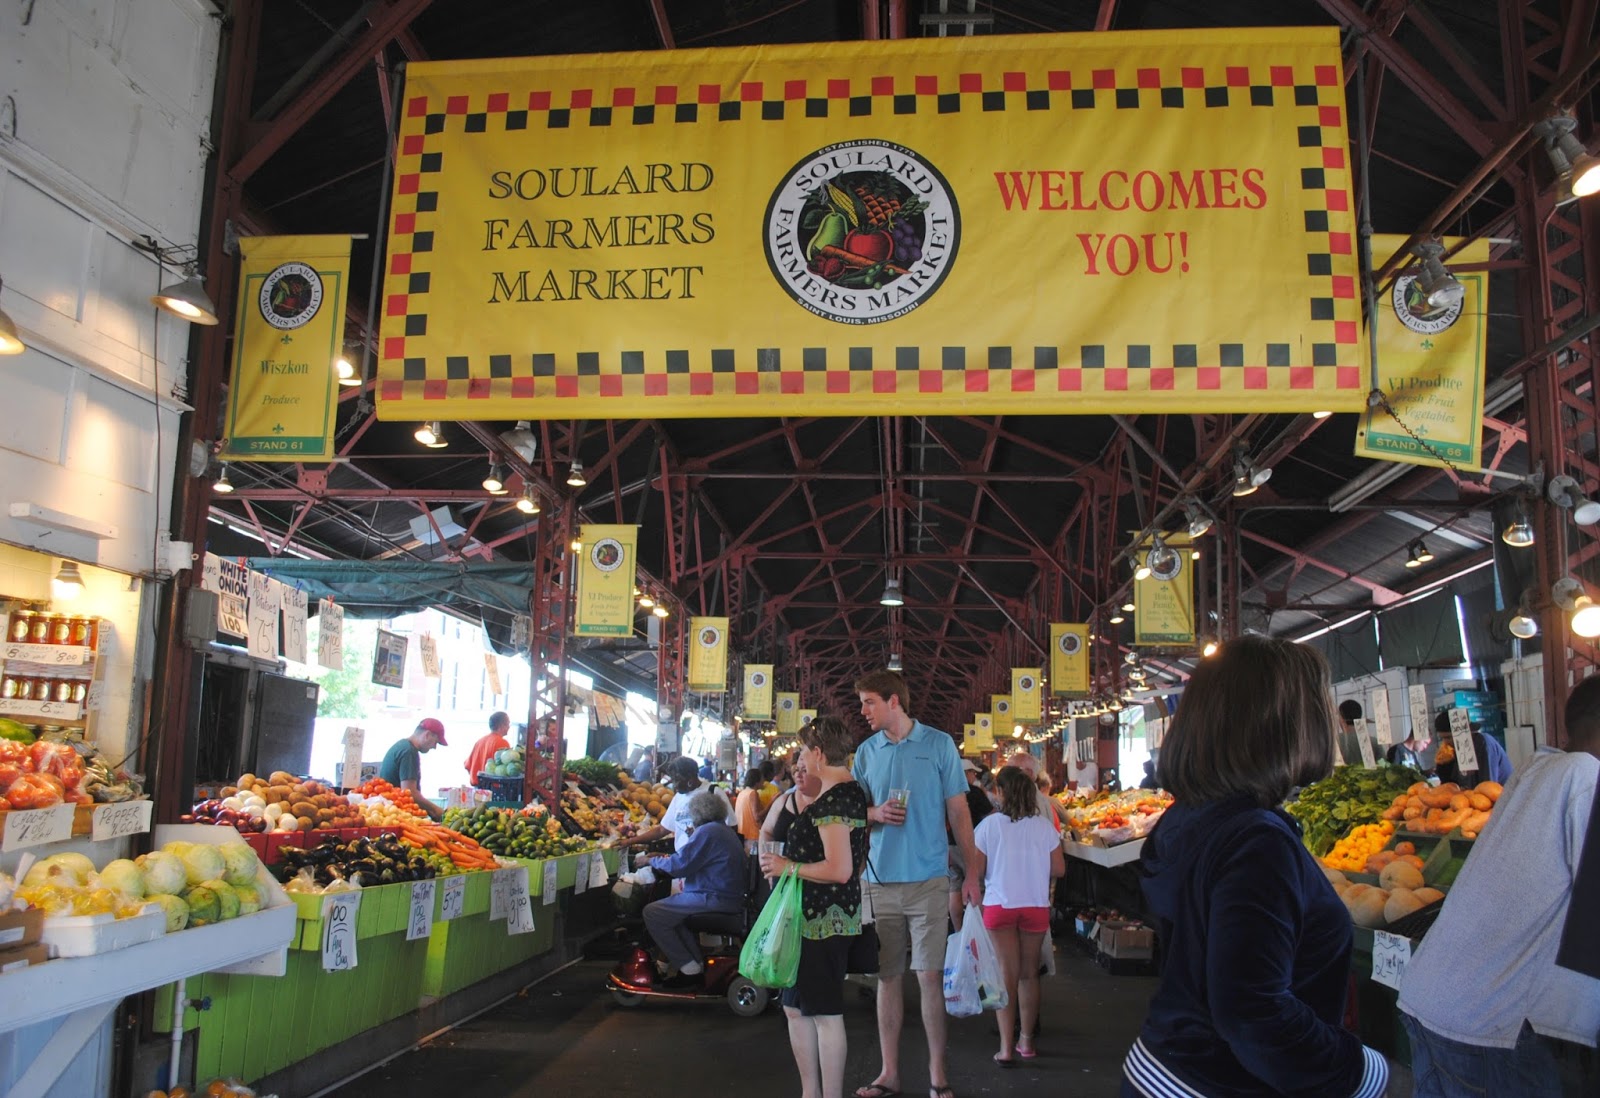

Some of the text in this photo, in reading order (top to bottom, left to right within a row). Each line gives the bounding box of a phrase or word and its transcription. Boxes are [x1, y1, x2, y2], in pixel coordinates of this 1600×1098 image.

[818, 139, 916, 158] ESTABLISHED 1779
[488, 162, 714, 200] SOULARD
[795, 151, 934, 195] SOULARD
[993, 168, 1268, 213] WELCOMES
[481, 212, 715, 251] FARMERS
[776, 206, 948, 312] FARMERS MARKET
[1075, 231, 1190, 276] YOU!
[269, 266, 317, 287] SOULARD
[487, 266, 704, 304] MARKET
[262, 289, 320, 326] FARMERS MARKET
[796, 297, 919, 325] SAINT LOUIS, MISSOURI
[259, 359, 309, 376] Wiszkon
[1409, 374, 1463, 390] Produce
[261, 394, 301, 406] Produce
[1427, 394, 1456, 408] Fruit
[1405, 405, 1456, 424] Vegetables
[250, 440, 304, 451] STAND 61
[1376, 437, 1417, 451] STAND
[1446, 448, 1462, 457] 66
[220, 559, 248, 584] WHITE
[218, 575, 248, 598] ONION
